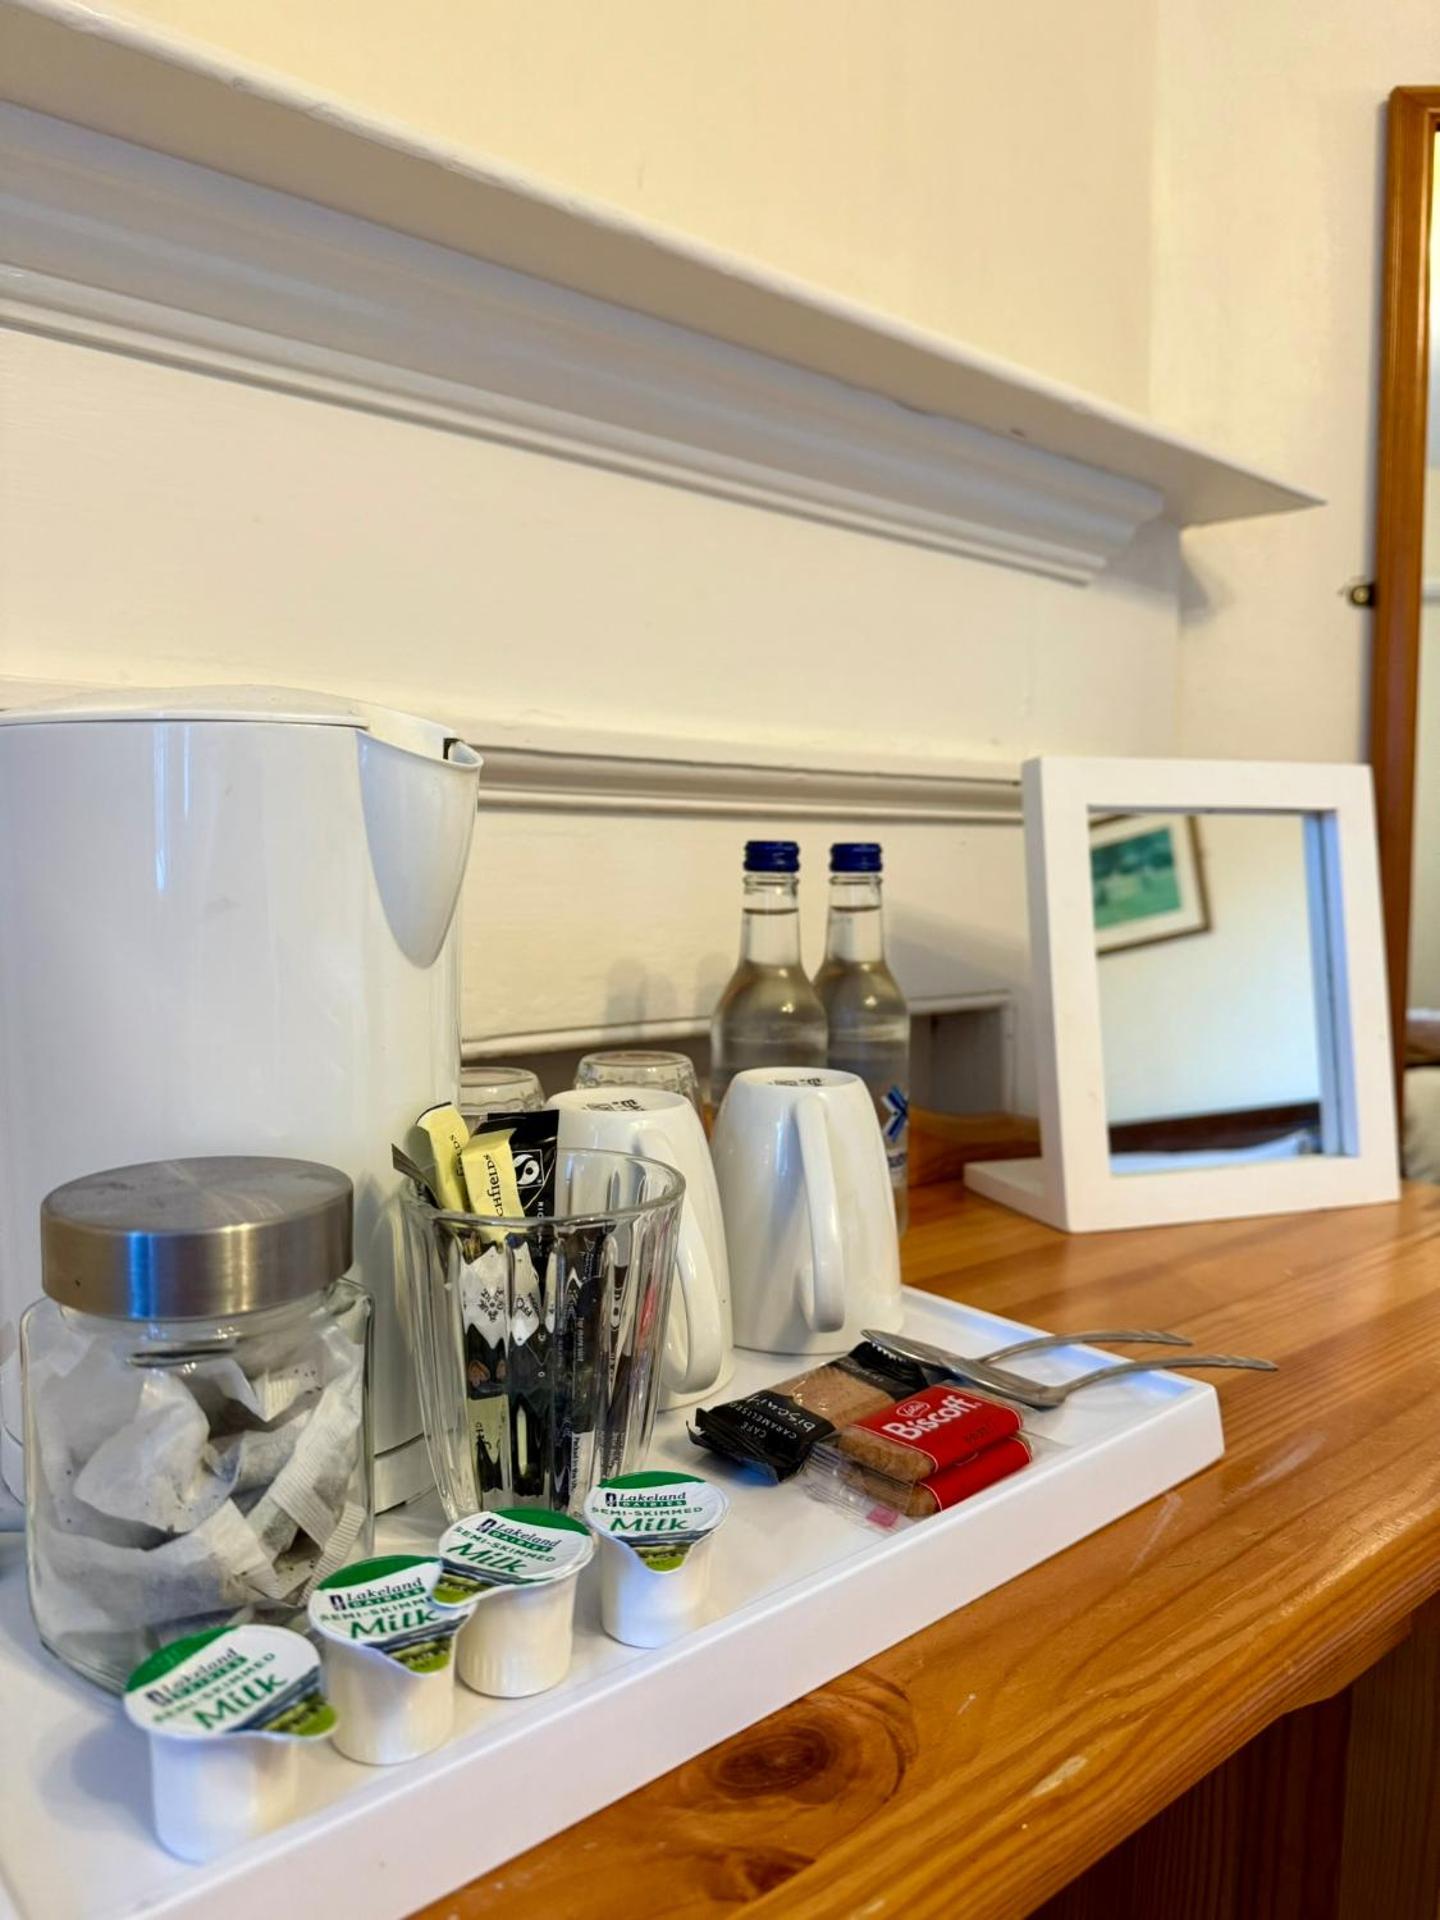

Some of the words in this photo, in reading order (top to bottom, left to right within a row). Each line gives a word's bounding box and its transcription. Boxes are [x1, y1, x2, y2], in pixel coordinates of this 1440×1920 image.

[881, 1395, 978, 1440] Biscoff
[619, 1491, 687, 1501] Lakeland
[591, 1507, 703, 1516] SEMI-SKIMMED
[610, 1517, 690, 1531] Milk
[453, 1526, 556, 1562] SEMI-SKIMMED
[495, 1523, 562, 1547] Lakeland
[446, 1542, 527, 1572] Milk
[346, 1577, 423, 1601] Lakeland
[350, 1609, 440, 1639] Milk
[193, 1673, 288, 1730] Milk
